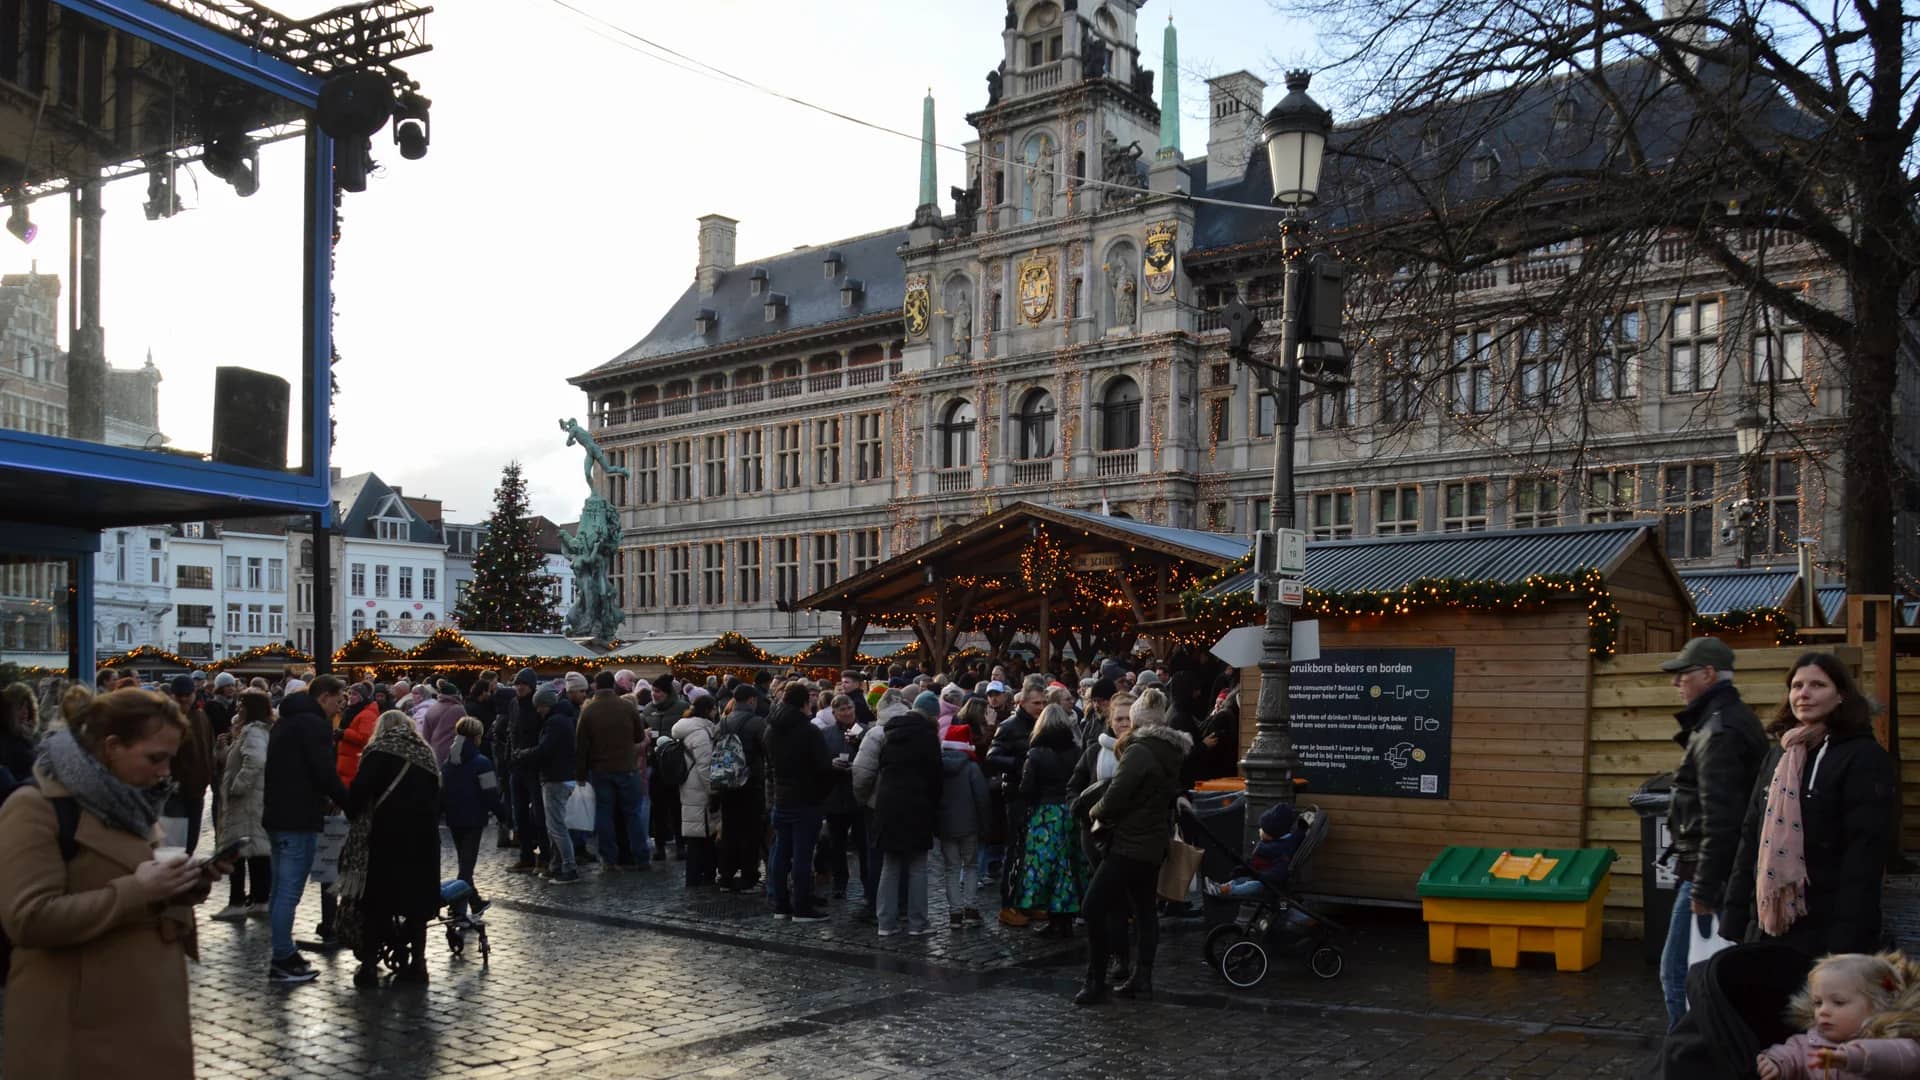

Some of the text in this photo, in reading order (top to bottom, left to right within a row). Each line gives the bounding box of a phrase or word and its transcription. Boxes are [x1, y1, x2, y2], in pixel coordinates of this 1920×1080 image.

[1334, 663, 1364, 673] bekers
[1366, 665, 1378, 673] en
[1380, 662, 1412, 673] borden
[1338, 684, 1356, 692] Betaal
[1405, 689, 1412, 697] of
[1320, 713, 1327, 721] of
[1327, 713, 1351, 721] drinken?
[1371, 714, 1377, 722] je
[1378, 714, 1390, 722] lege
[1391, 714, 1408, 722] beker
[1291, 721, 1304, 729] bord
[1356, 722, 1377, 731] drankje
[1310, 744, 1316, 752] je
[1339, 744, 1354, 752] Lever
[1355, 744, 1361, 753] je
[1361, 744, 1374, 753] lege
[1303, 761, 1330, 769] waarborg
